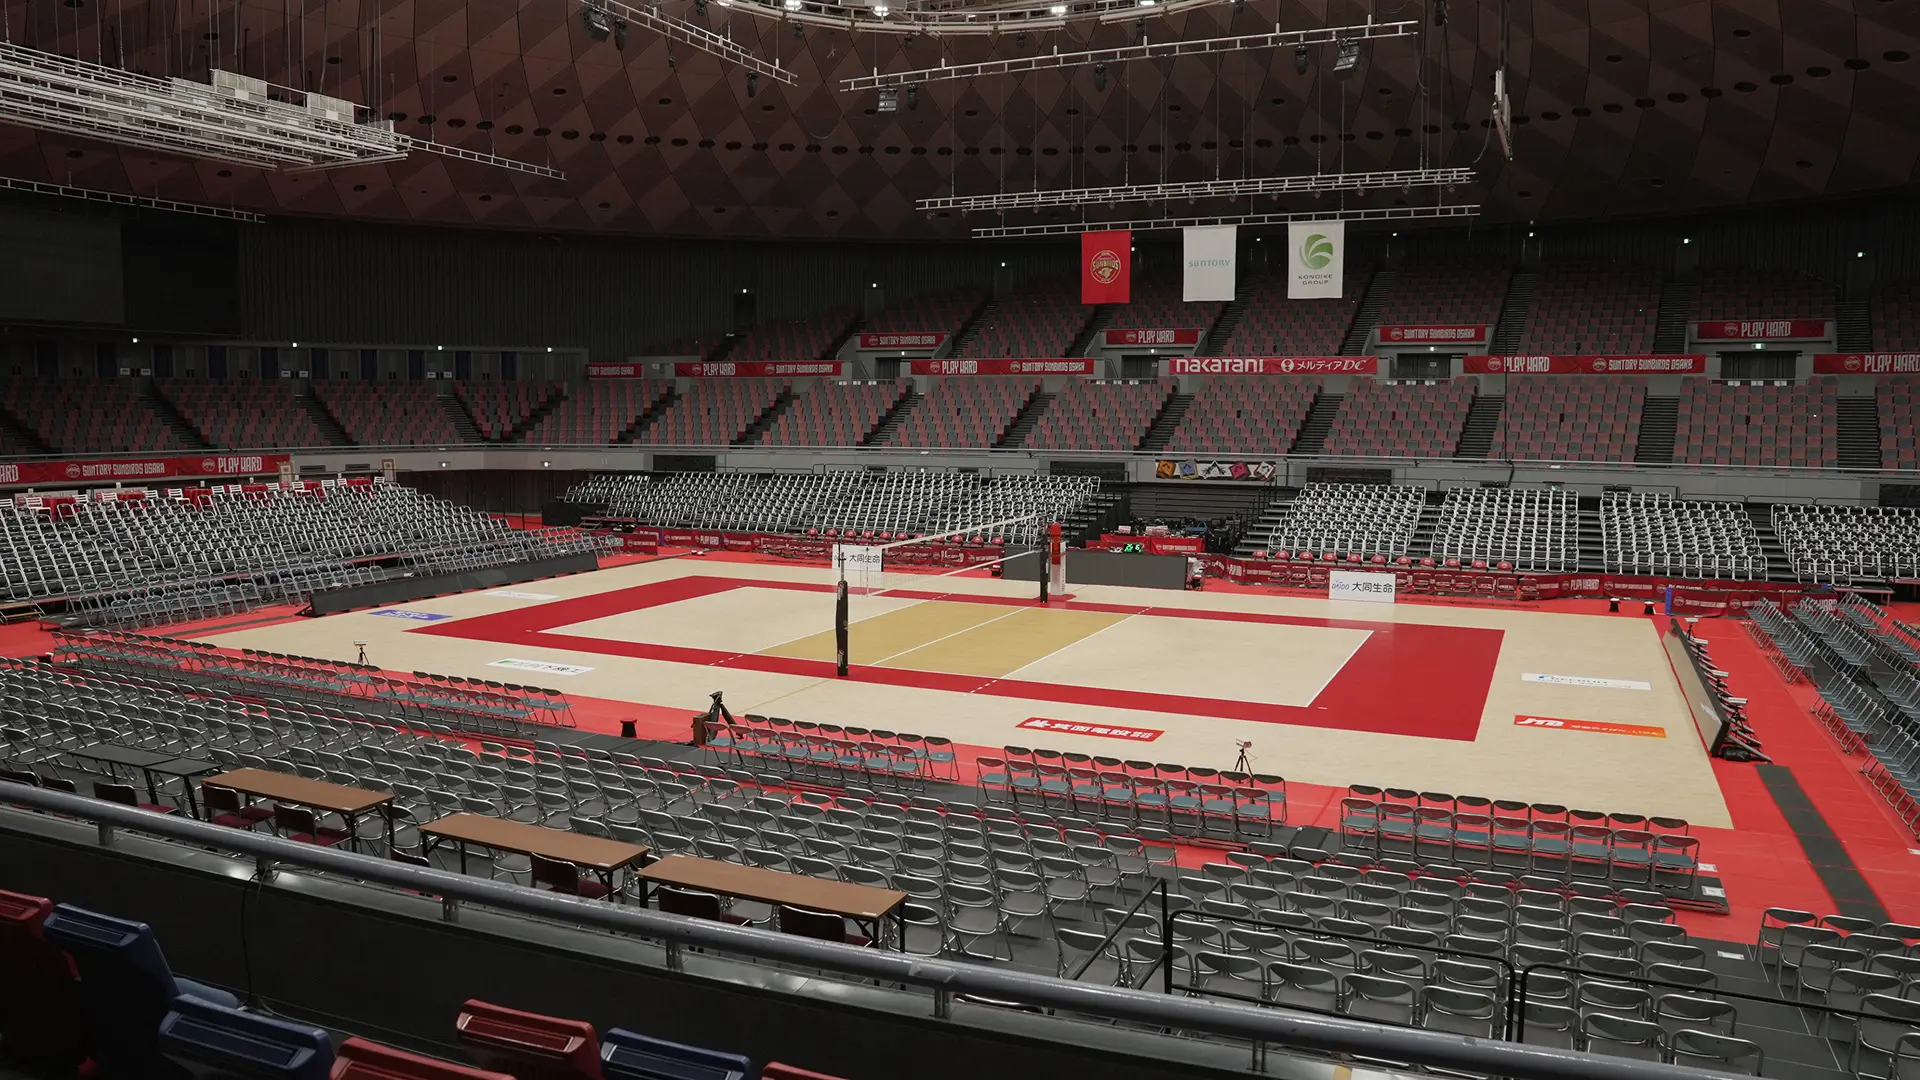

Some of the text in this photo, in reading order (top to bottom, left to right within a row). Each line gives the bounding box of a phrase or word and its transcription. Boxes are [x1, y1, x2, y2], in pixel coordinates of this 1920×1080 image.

[1188, 259, 1231, 268] SUNTORY
[1741, 321, 1792, 337] PLAY HARD
[1138, 330, 1175, 343] PLAY HARD
[703, 363, 719, 376] PLAY
[942, 360, 978, 374] PLAY HARD
[1503, 356, 1550, 372] PLAY HARD
[1608, 359, 1638, 371] SUNTORY
[1864, 355, 1892, 372] PLAY
[82, 462, 165, 476] SUNTORY SUNBIRDS OSAKA
[218, 456, 262, 473] PLAY HARD
[849, 553, 881, 563] 大同生命
[1352, 582, 1393, 593] 大同生命
